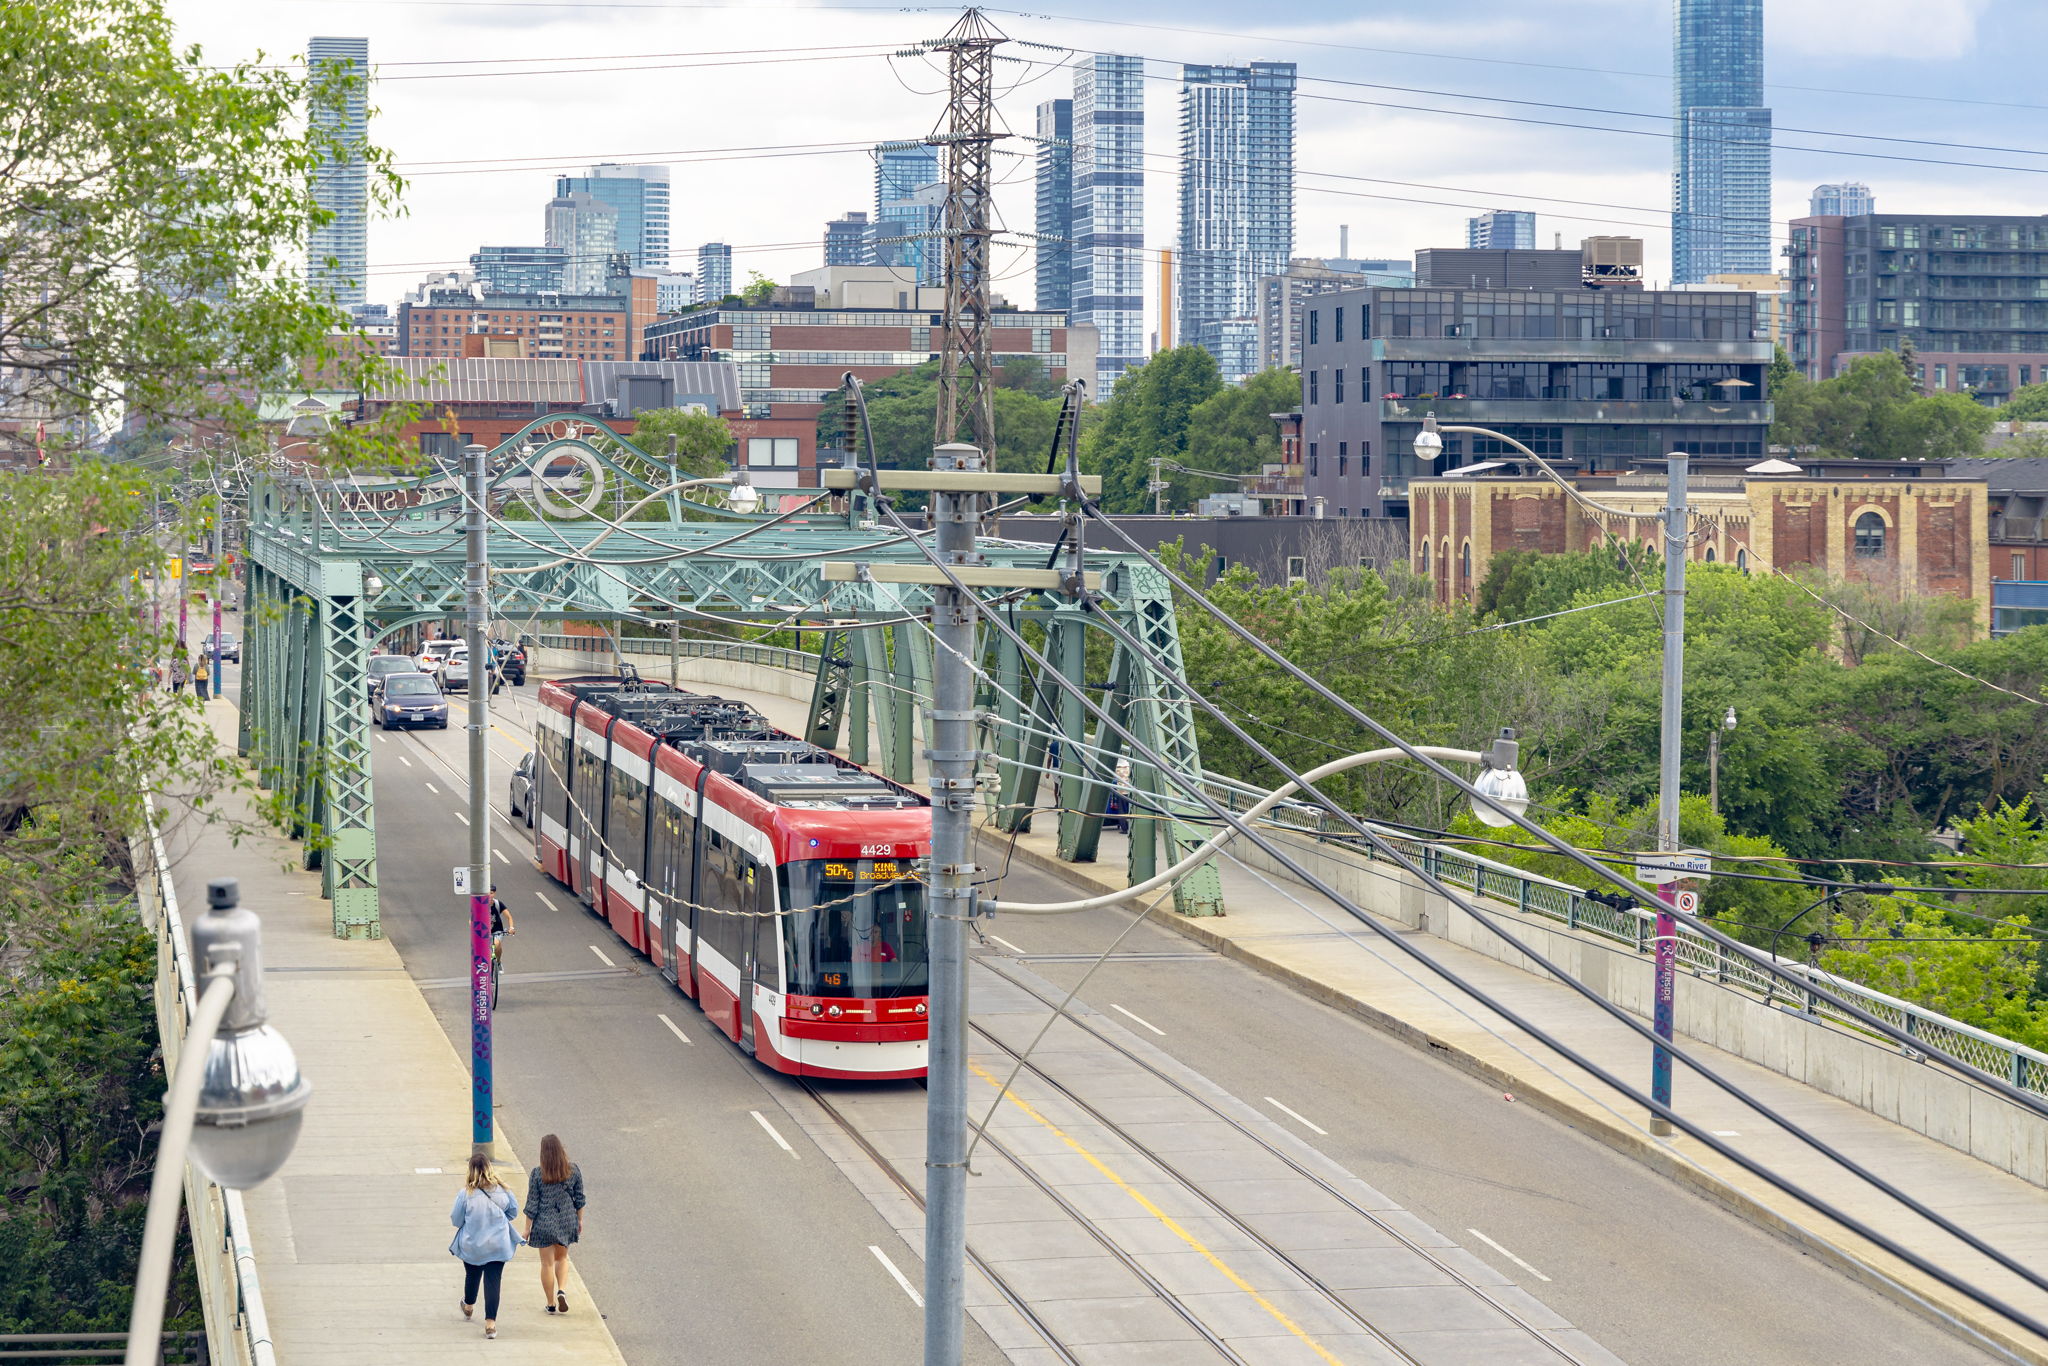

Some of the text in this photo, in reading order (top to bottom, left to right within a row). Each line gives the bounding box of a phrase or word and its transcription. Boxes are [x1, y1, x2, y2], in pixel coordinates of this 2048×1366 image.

[861, 844, 891, 855] 4429
[874, 862, 897, 872] KING
[1687, 861, 1708, 870] River
[479, 976, 487, 1021] RIVERSIDE
